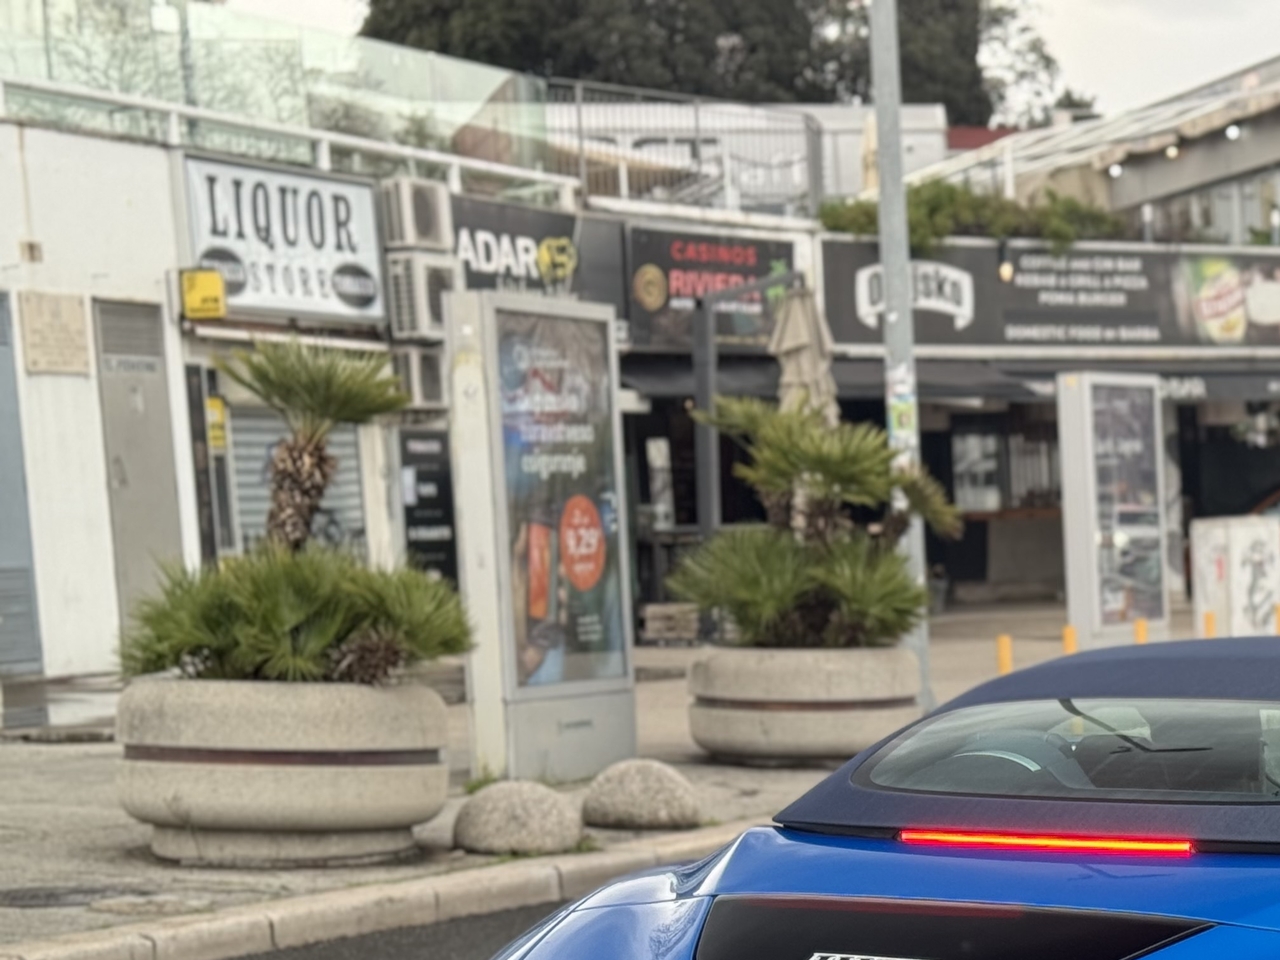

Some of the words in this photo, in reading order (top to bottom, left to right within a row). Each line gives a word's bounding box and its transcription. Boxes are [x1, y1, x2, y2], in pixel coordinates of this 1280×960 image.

[205, 174, 358, 254] LIQUOR
[457, 227, 540, 280] ADAR
[670, 240, 757, 267] CASINOS
[250, 262, 330, 299] STORE
